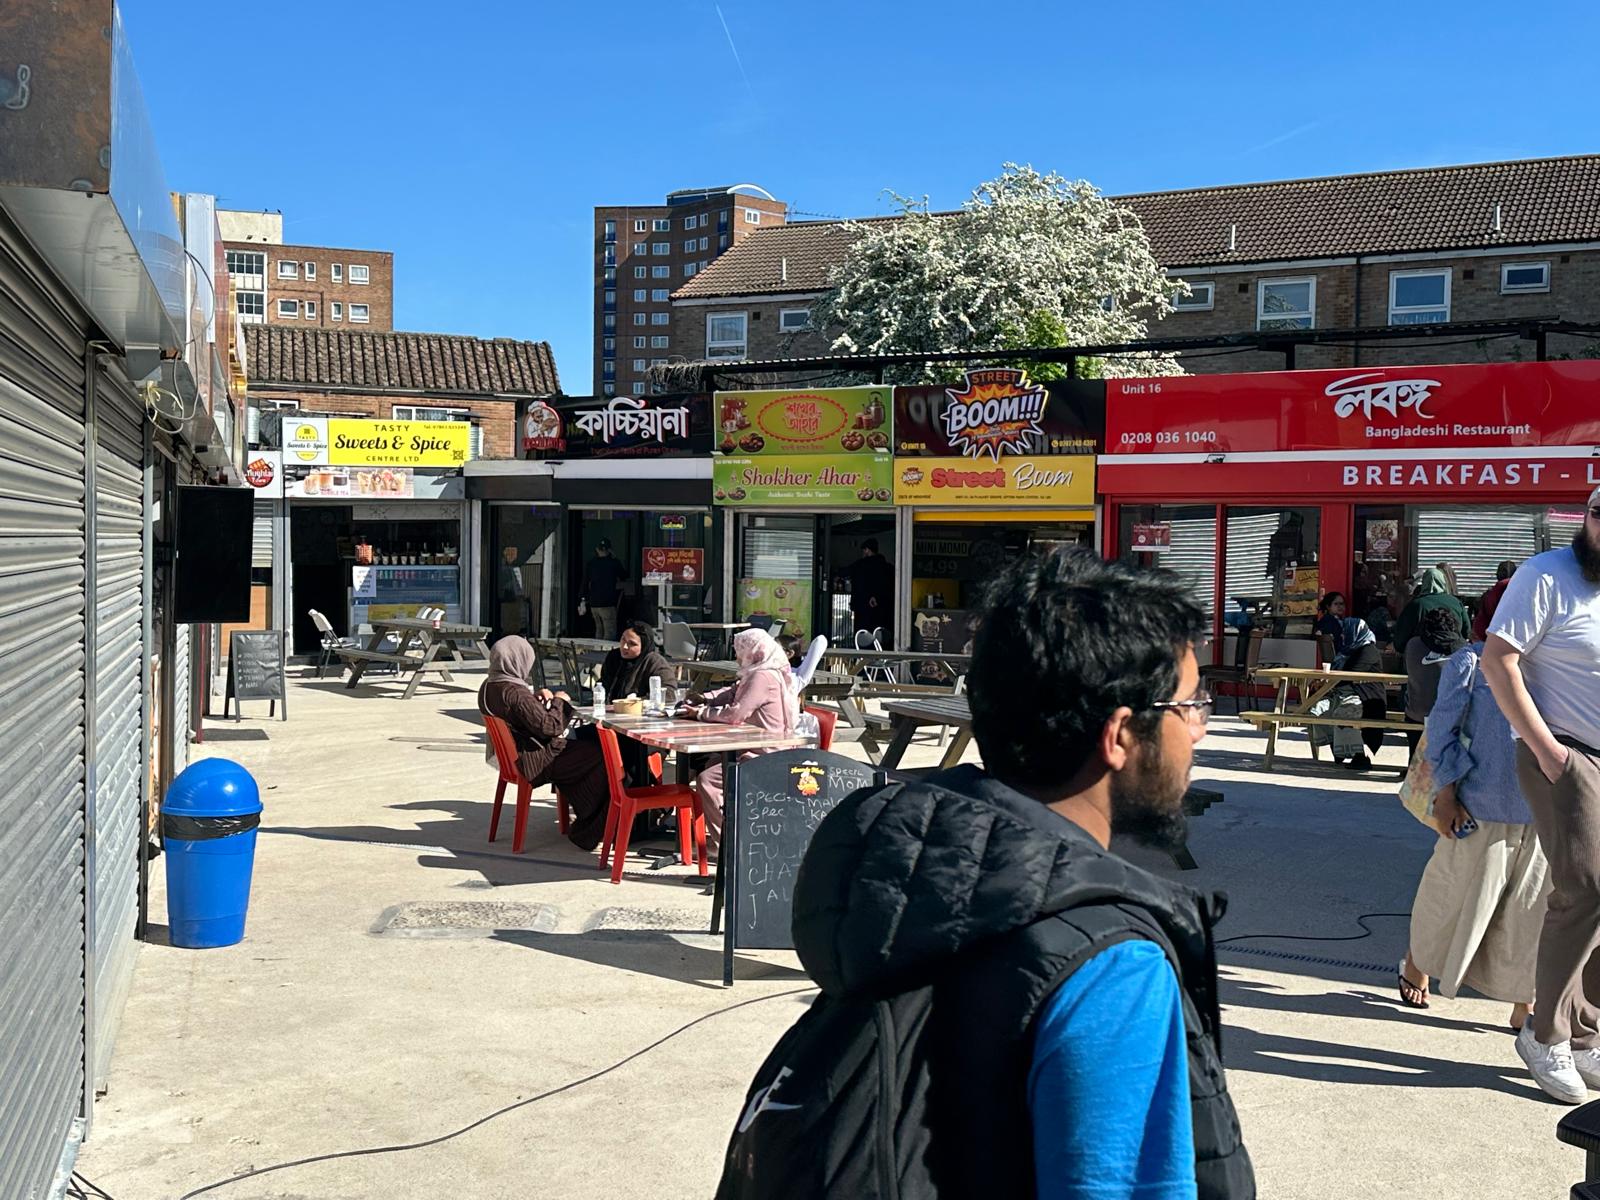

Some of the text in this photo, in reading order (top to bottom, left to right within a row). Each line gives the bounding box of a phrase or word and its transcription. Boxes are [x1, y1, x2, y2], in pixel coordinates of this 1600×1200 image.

[971, 371, 1018, 384] STREET
[1121, 383, 1162, 395] Unit 16
[950, 393, 1042, 433] BOOM!!!
[374, 424, 410, 432] TASTY
[1365, 423, 1531, 440] Bangladeshi Restaurant
[334, 434, 451, 455] Sweets & Spice
[1120, 431, 1217, 444] 0208 036 1040
[741, 466, 861, 486] Shokher Ahar
[931, 462, 1074, 490] Street Boom
[1343, 463, 1546, 486] BREAKFAST
